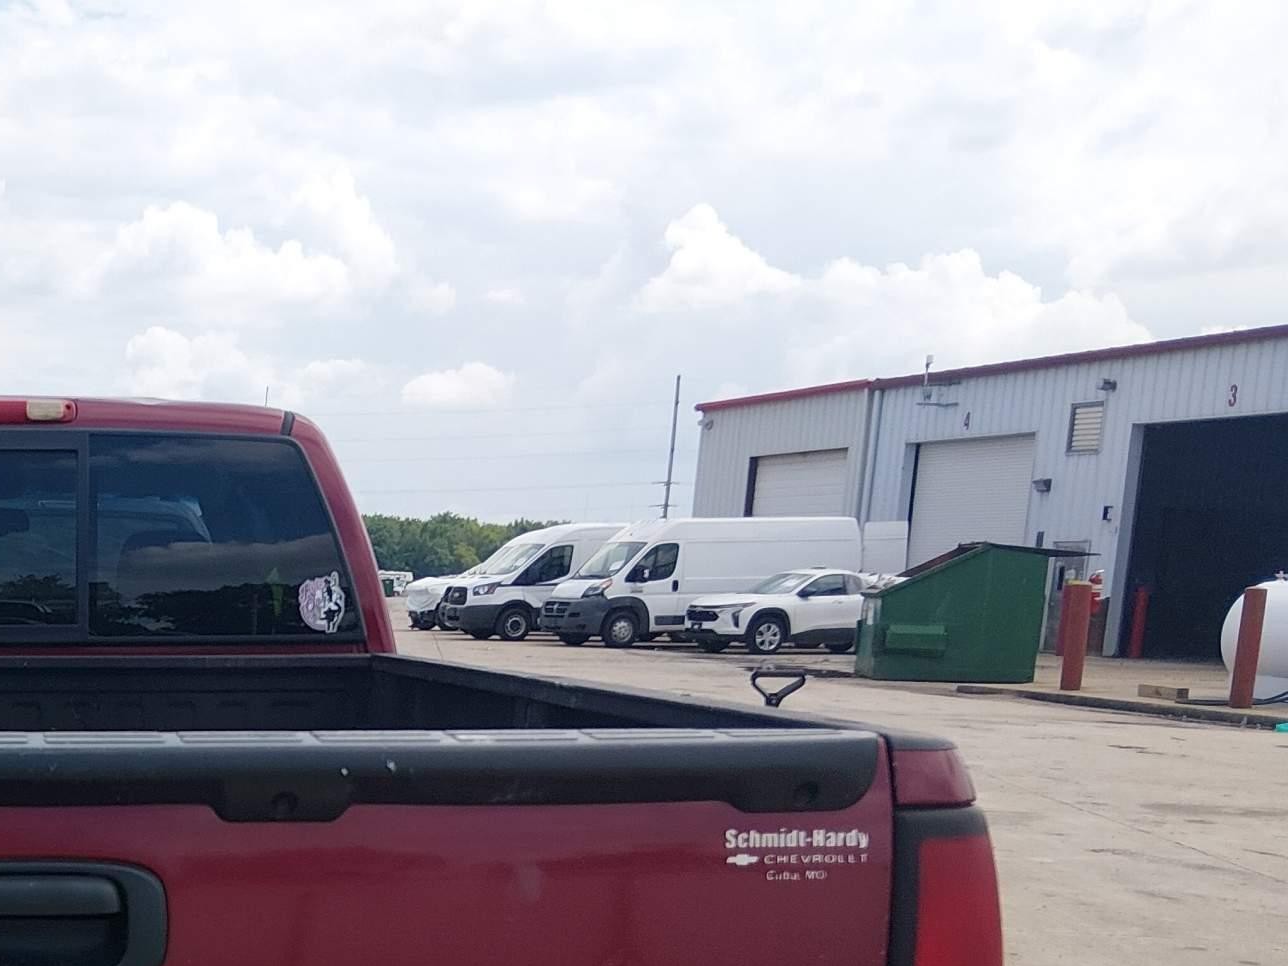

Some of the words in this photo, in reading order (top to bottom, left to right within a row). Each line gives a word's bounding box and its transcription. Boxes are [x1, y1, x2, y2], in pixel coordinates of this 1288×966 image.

[1227, 383, 1239, 408] 3
[963, 411, 971, 431] 4
[724, 827, 870, 849] Schmidt-Hardy
[763, 853, 869, 865] CHEVROLET
